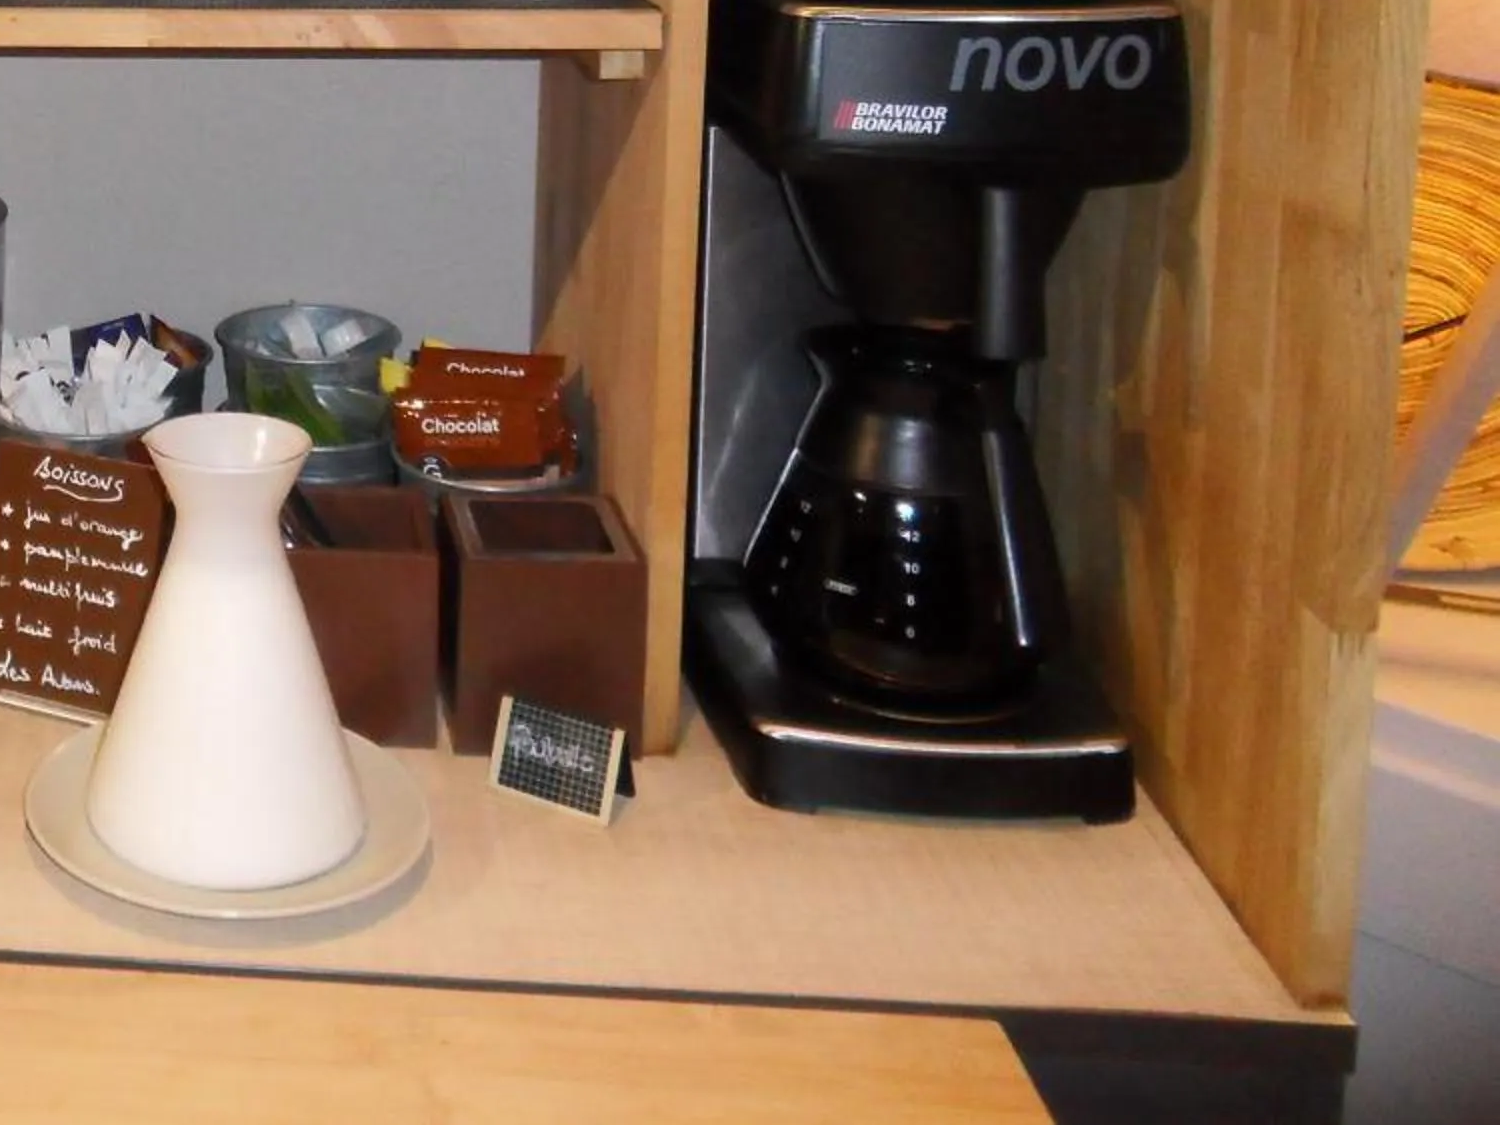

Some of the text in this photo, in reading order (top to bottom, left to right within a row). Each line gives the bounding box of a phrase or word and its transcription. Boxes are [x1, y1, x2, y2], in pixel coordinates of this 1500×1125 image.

[949, 34, 1151, 92] novo
[855, 102, 948, 120] BRAVILOR
[851, 116, 946, 134] BONAMAT
[421, 417, 500, 434] Chocolat
[68, 625, 116, 655] froid
